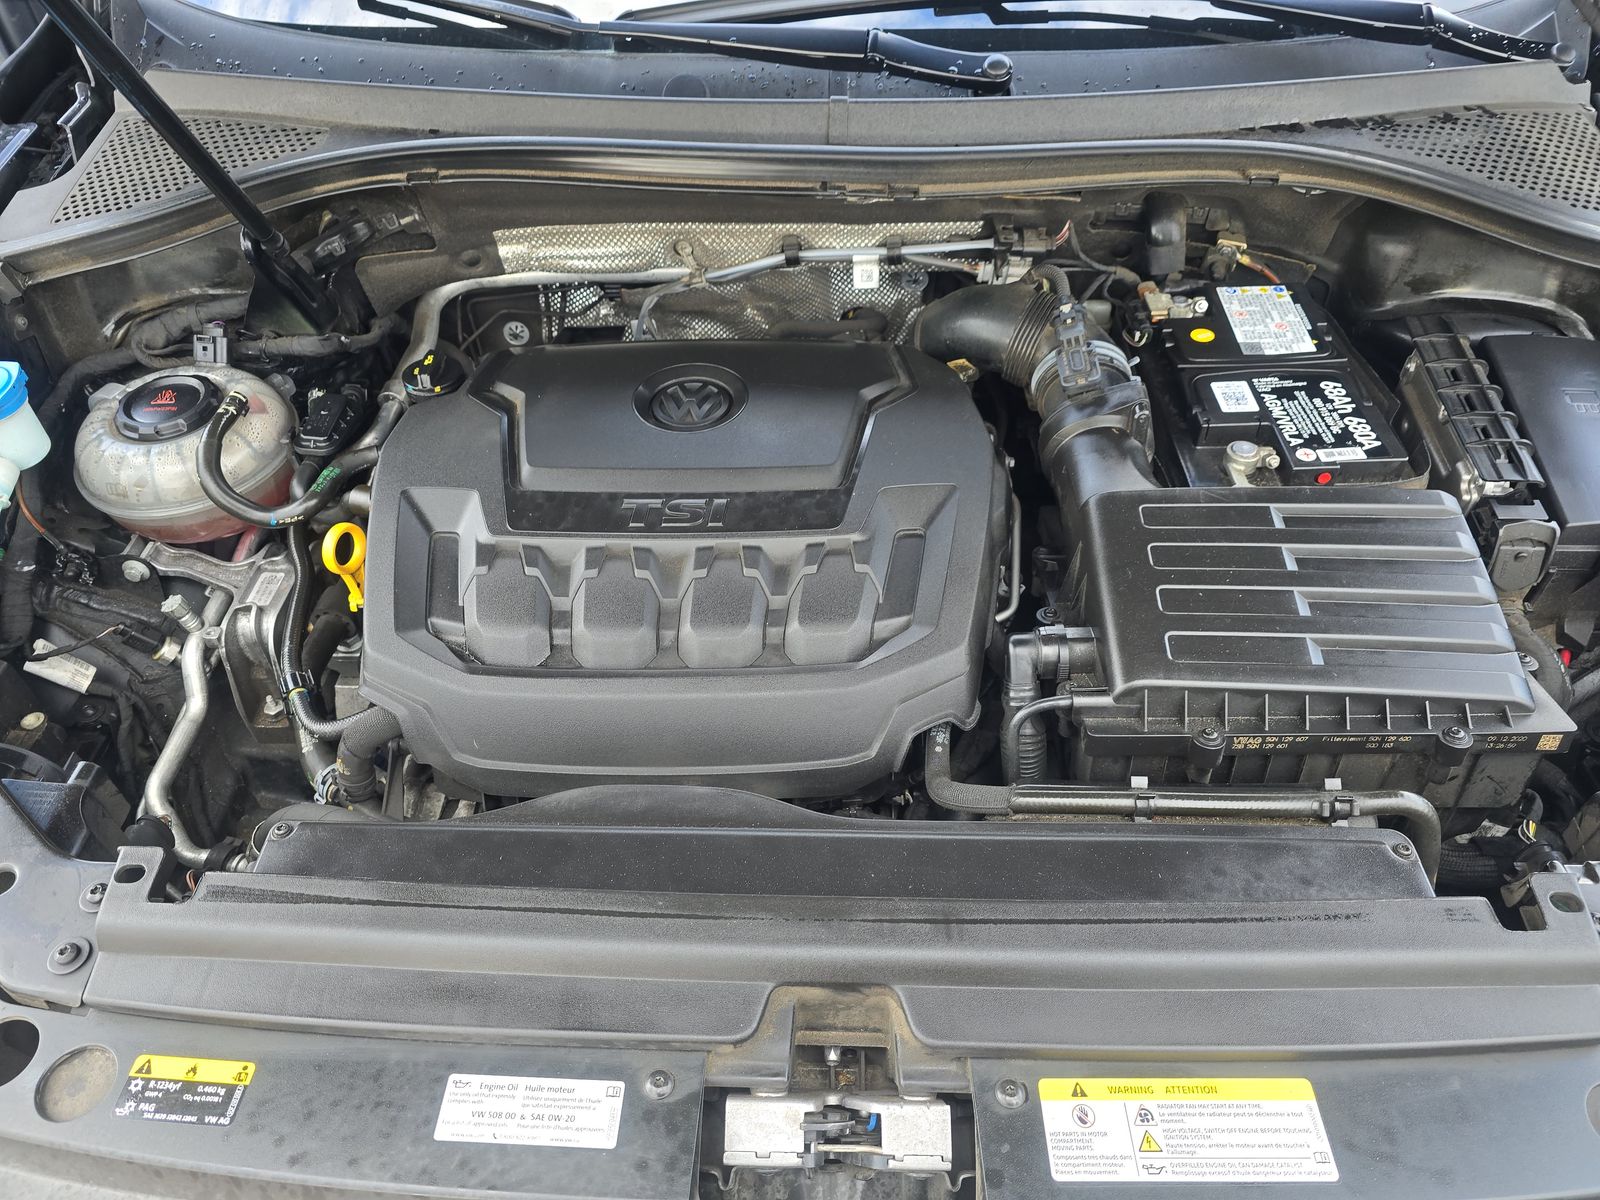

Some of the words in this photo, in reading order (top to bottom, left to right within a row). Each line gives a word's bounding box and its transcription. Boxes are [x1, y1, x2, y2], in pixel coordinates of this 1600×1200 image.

[1320, 380, 1356, 414] 68Ah
[1344, 416, 1382, 450] 680A
[1260, 394, 1304, 447] AGM/VRLA
[622, 498, 730, 527] TSI
[149, 1080, 182, 1092] R-1234yf
[217, 1087, 226, 1096] kg
[480, 1082, 506, 1092] Engine
[1107, 1086, 1154, 1094] WARNING
[1166, 1086, 1218, 1094] ATTENTION
[138, 1103, 156, 1112] PAG
[218, 1116, 231, 1125] AG
[531, 1113, 545, 1121] SAE
